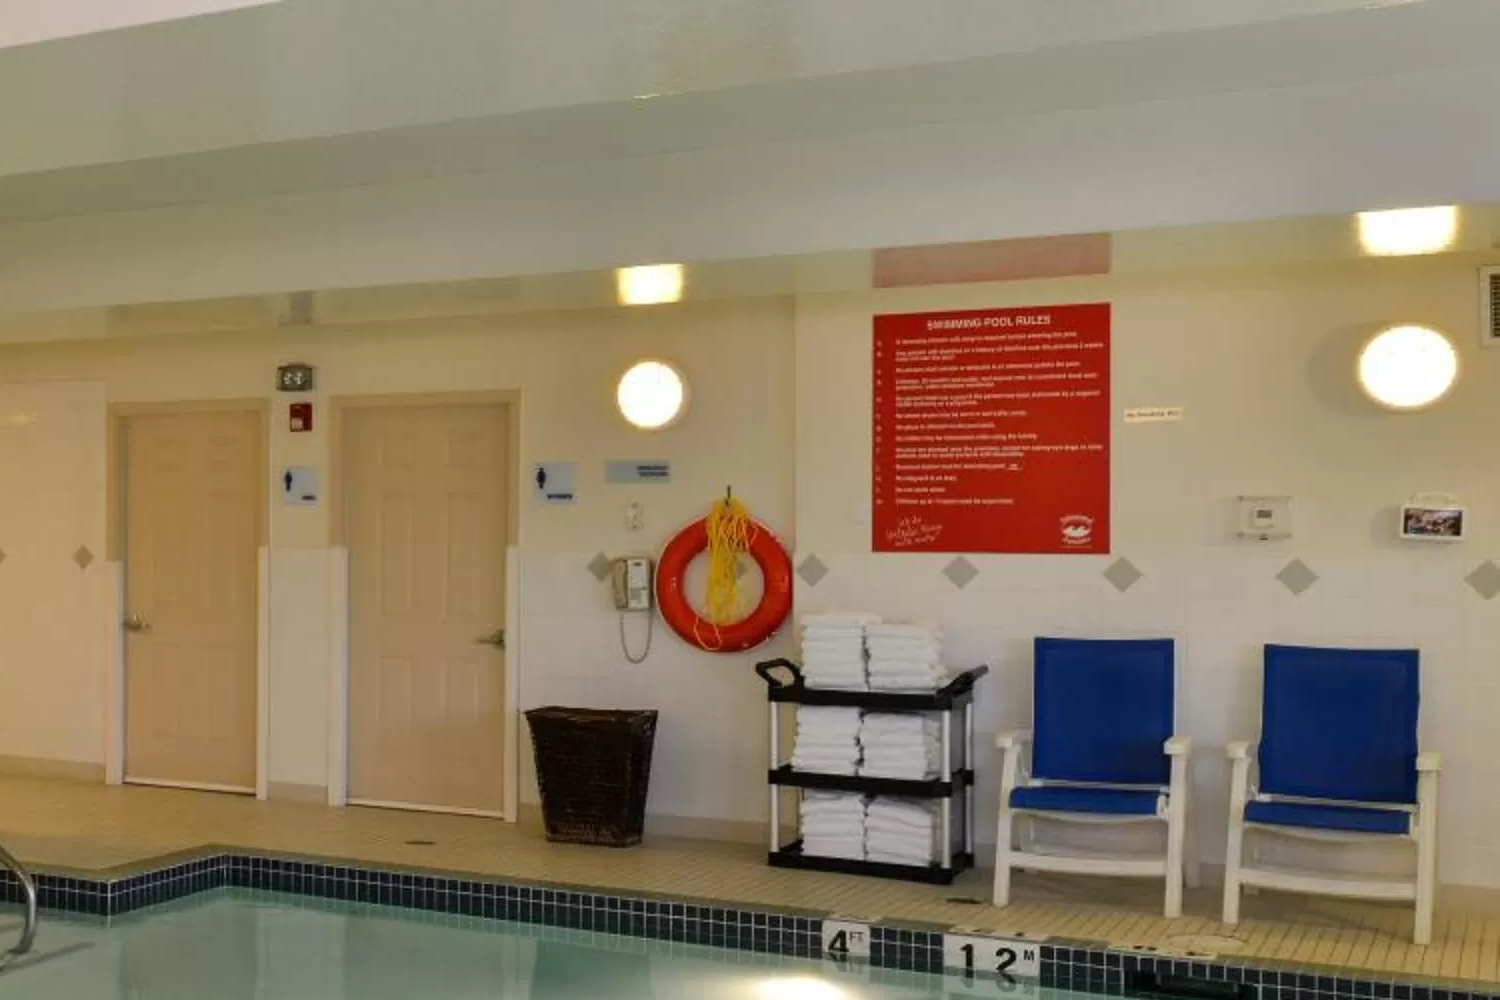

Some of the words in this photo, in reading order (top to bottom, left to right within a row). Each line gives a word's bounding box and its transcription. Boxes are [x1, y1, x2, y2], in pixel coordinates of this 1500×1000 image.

[926, 318, 982, 331] SWIMMING
[983, 316, 1015, 328] POOL
[1015, 314, 1051, 326] RULES
[828, 929, 850, 953] 4
[849, 931, 864, 942] FT
[1023, 949, 1036, 962] M
